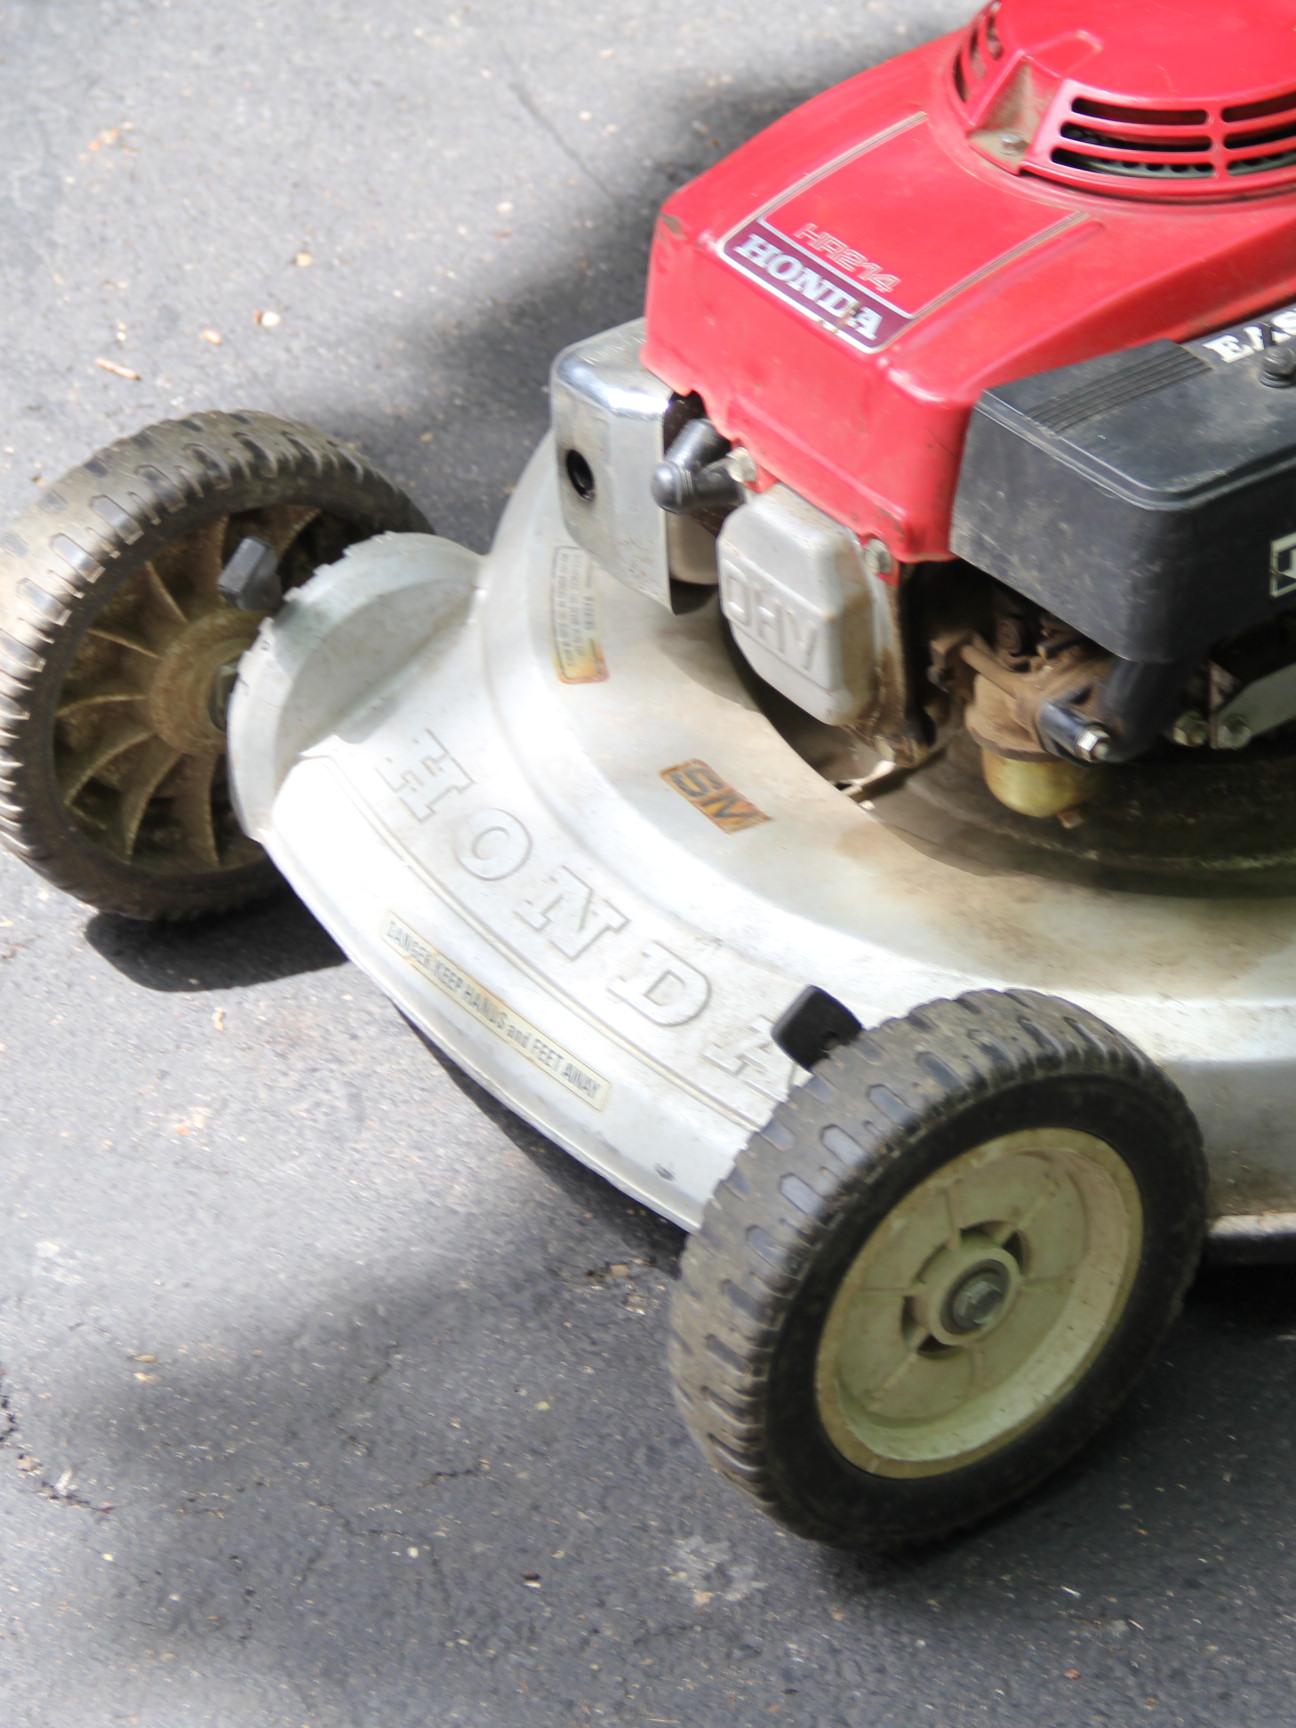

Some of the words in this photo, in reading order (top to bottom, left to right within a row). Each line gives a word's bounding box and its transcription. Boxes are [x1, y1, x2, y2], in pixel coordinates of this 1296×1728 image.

[734, 234, 885, 341] HONDA
[794, 222, 901, 294] HR214
[722, 556, 820, 673] OHV
[433, 959, 464, 994] KEEP
[463, 986, 508, 1030] HANDS
[507, 1024, 532, 1049] and
[533, 1038, 565, 1072] FEET
[563, 1063, 602, 1100] AWAY
